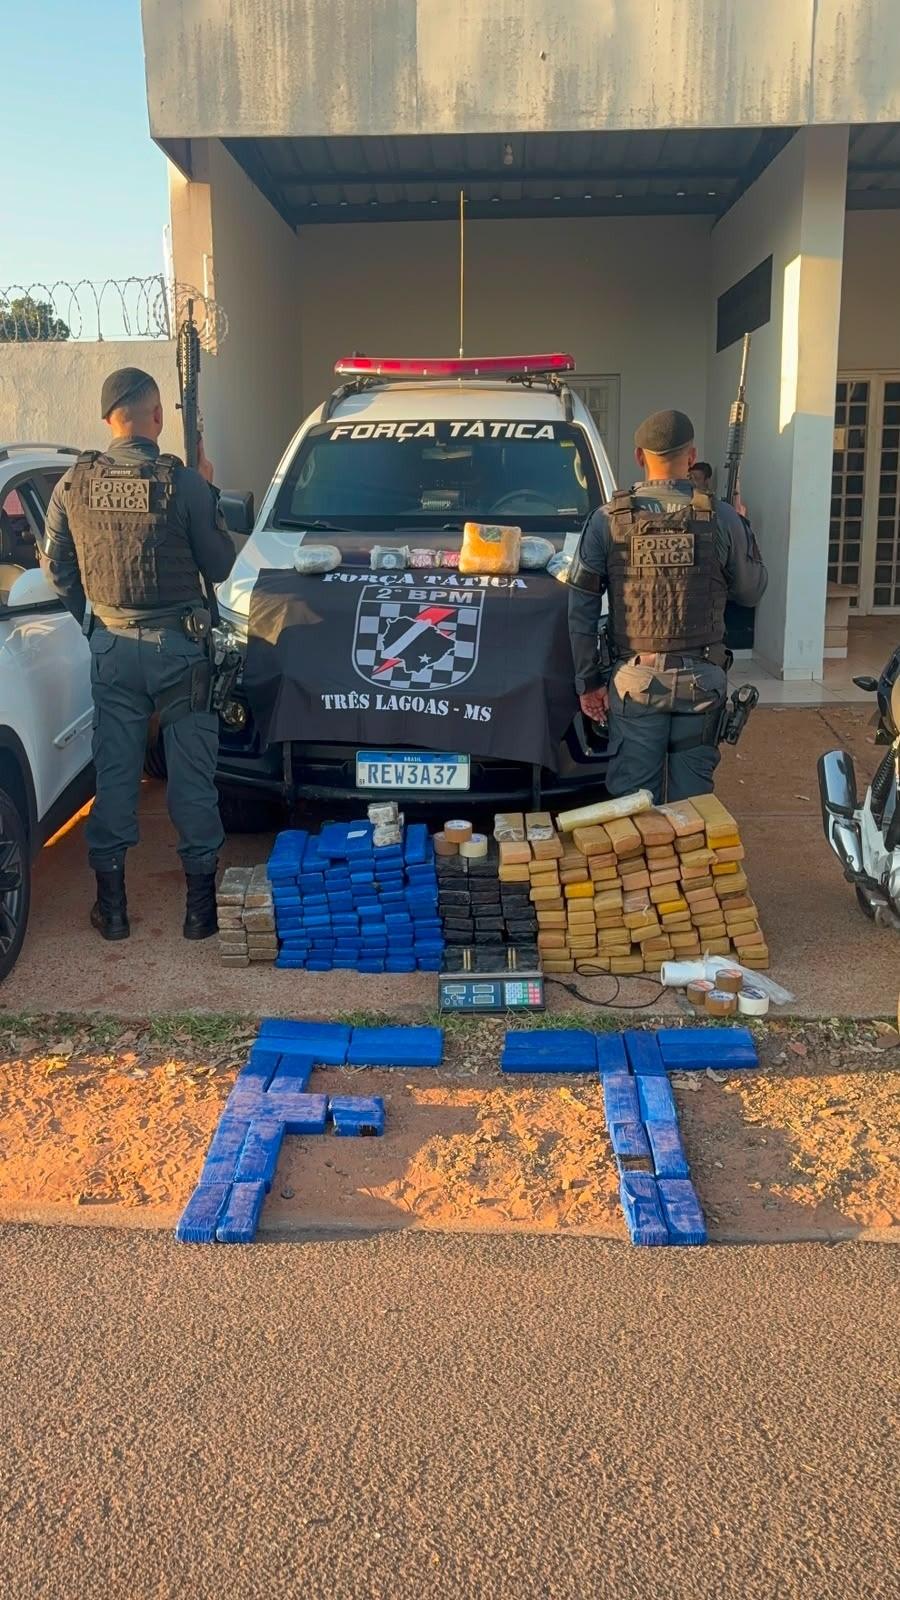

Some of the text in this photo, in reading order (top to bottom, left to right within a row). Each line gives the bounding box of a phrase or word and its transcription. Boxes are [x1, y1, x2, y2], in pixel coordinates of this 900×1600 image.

[330, 420, 555, 442] FORÇA TÁTICA
[92, 482, 147, 496] FORÇA
[92, 494, 147, 508] TÁTICA
[634, 537, 690, 552] FORÇA
[634, 551, 691, 565] TÁTICA
[322, 573, 528, 589] FORÇA TÁTICA
[408, 590, 473, 604] BPM
[321, 691, 370, 710] TRÊS
[375, 694, 449, 716] LAGOAS
[463, 703, 492, 722] MS
[368, 764, 457, 785] REW3A37
